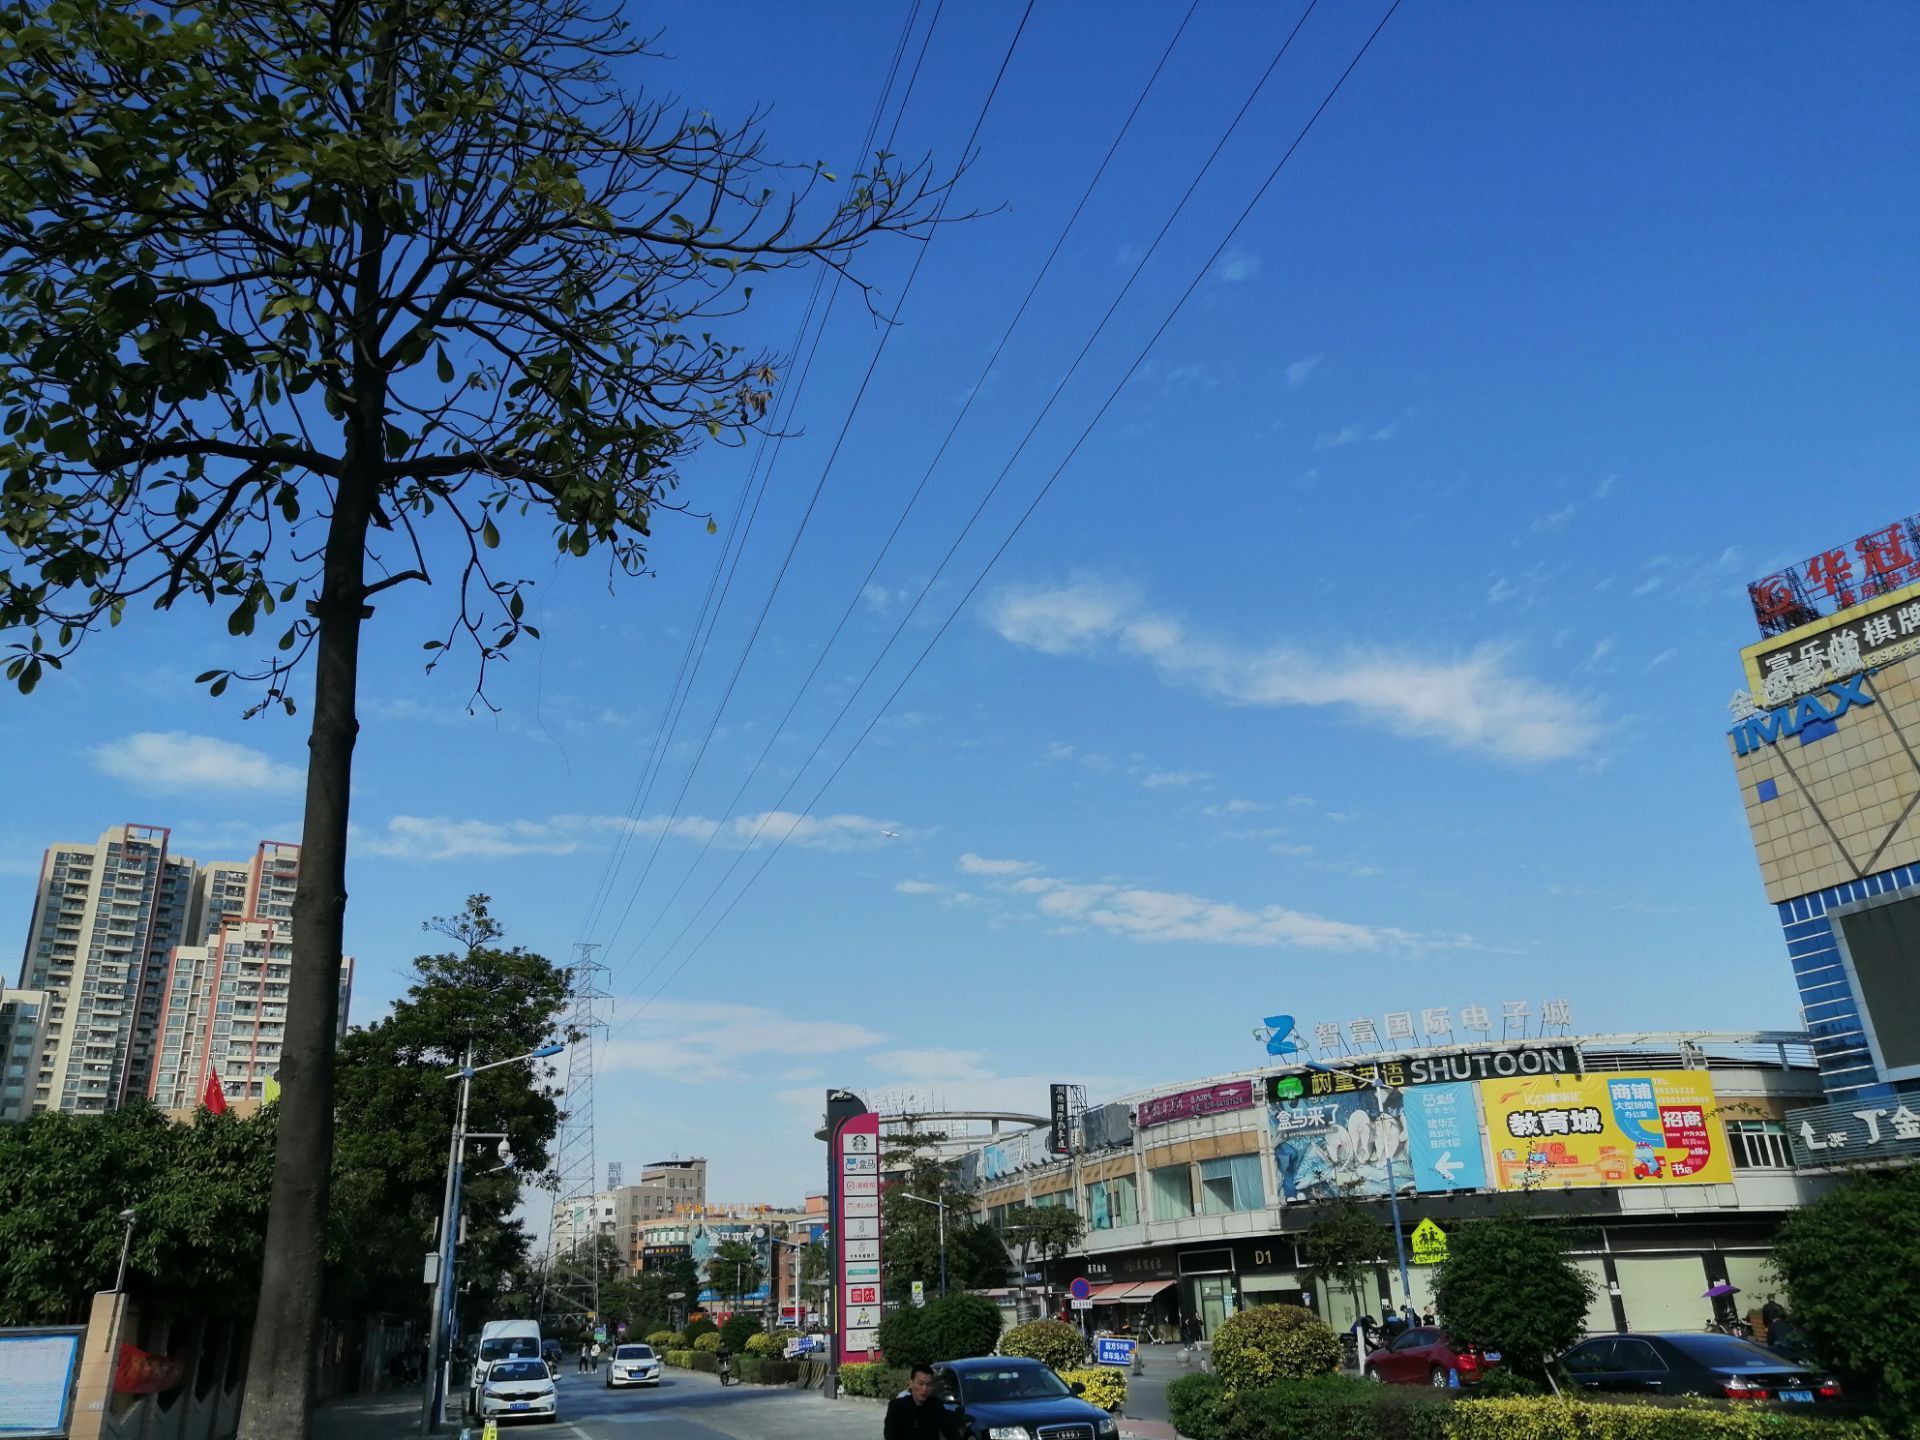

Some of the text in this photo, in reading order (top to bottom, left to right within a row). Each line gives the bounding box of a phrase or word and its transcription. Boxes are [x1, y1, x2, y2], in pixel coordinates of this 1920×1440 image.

[1804, 523, 1920, 595] 华冠
[1731, 672, 1875, 757] IMAX
[1314, 998, 1571, 1048] 智富国际电子城
[1410, 1049, 1566, 1083] SHUTOON
[1610, 1083, 1652, 1100] 商铺
[1276, 1104, 1340, 1131] 盒马来了
[1508, 1108, 1602, 1137] 教育城
[1662, 1111, 1703, 1128] 招商
[1255, 1250, 1272, 1265] D1
